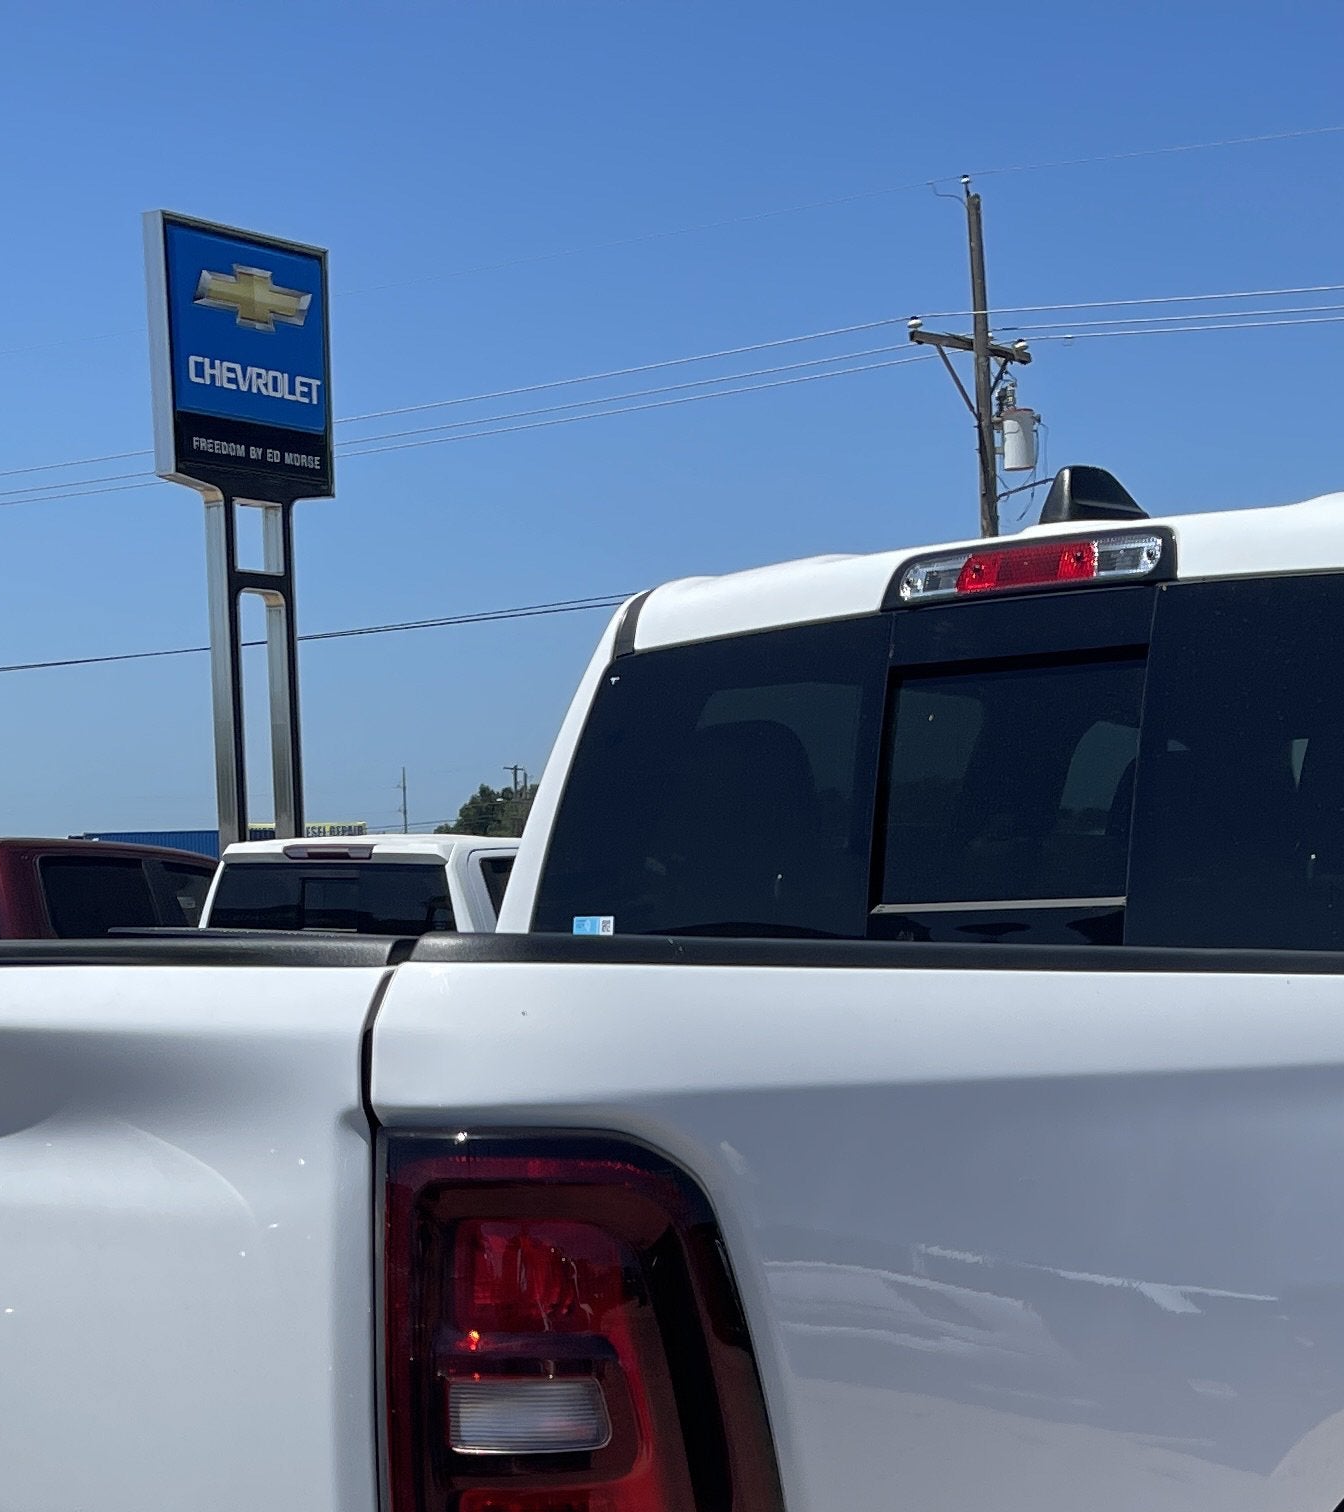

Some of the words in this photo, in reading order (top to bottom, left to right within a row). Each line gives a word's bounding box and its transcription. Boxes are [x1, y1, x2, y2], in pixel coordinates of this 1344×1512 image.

[188, 355, 321, 405] CHEVROLET
[192, 437, 246, 458] FREEDOM
[249, 442, 263, 461] BY
[267, 448, 281, 463] ED
[284, 451, 321, 470] MORSE
